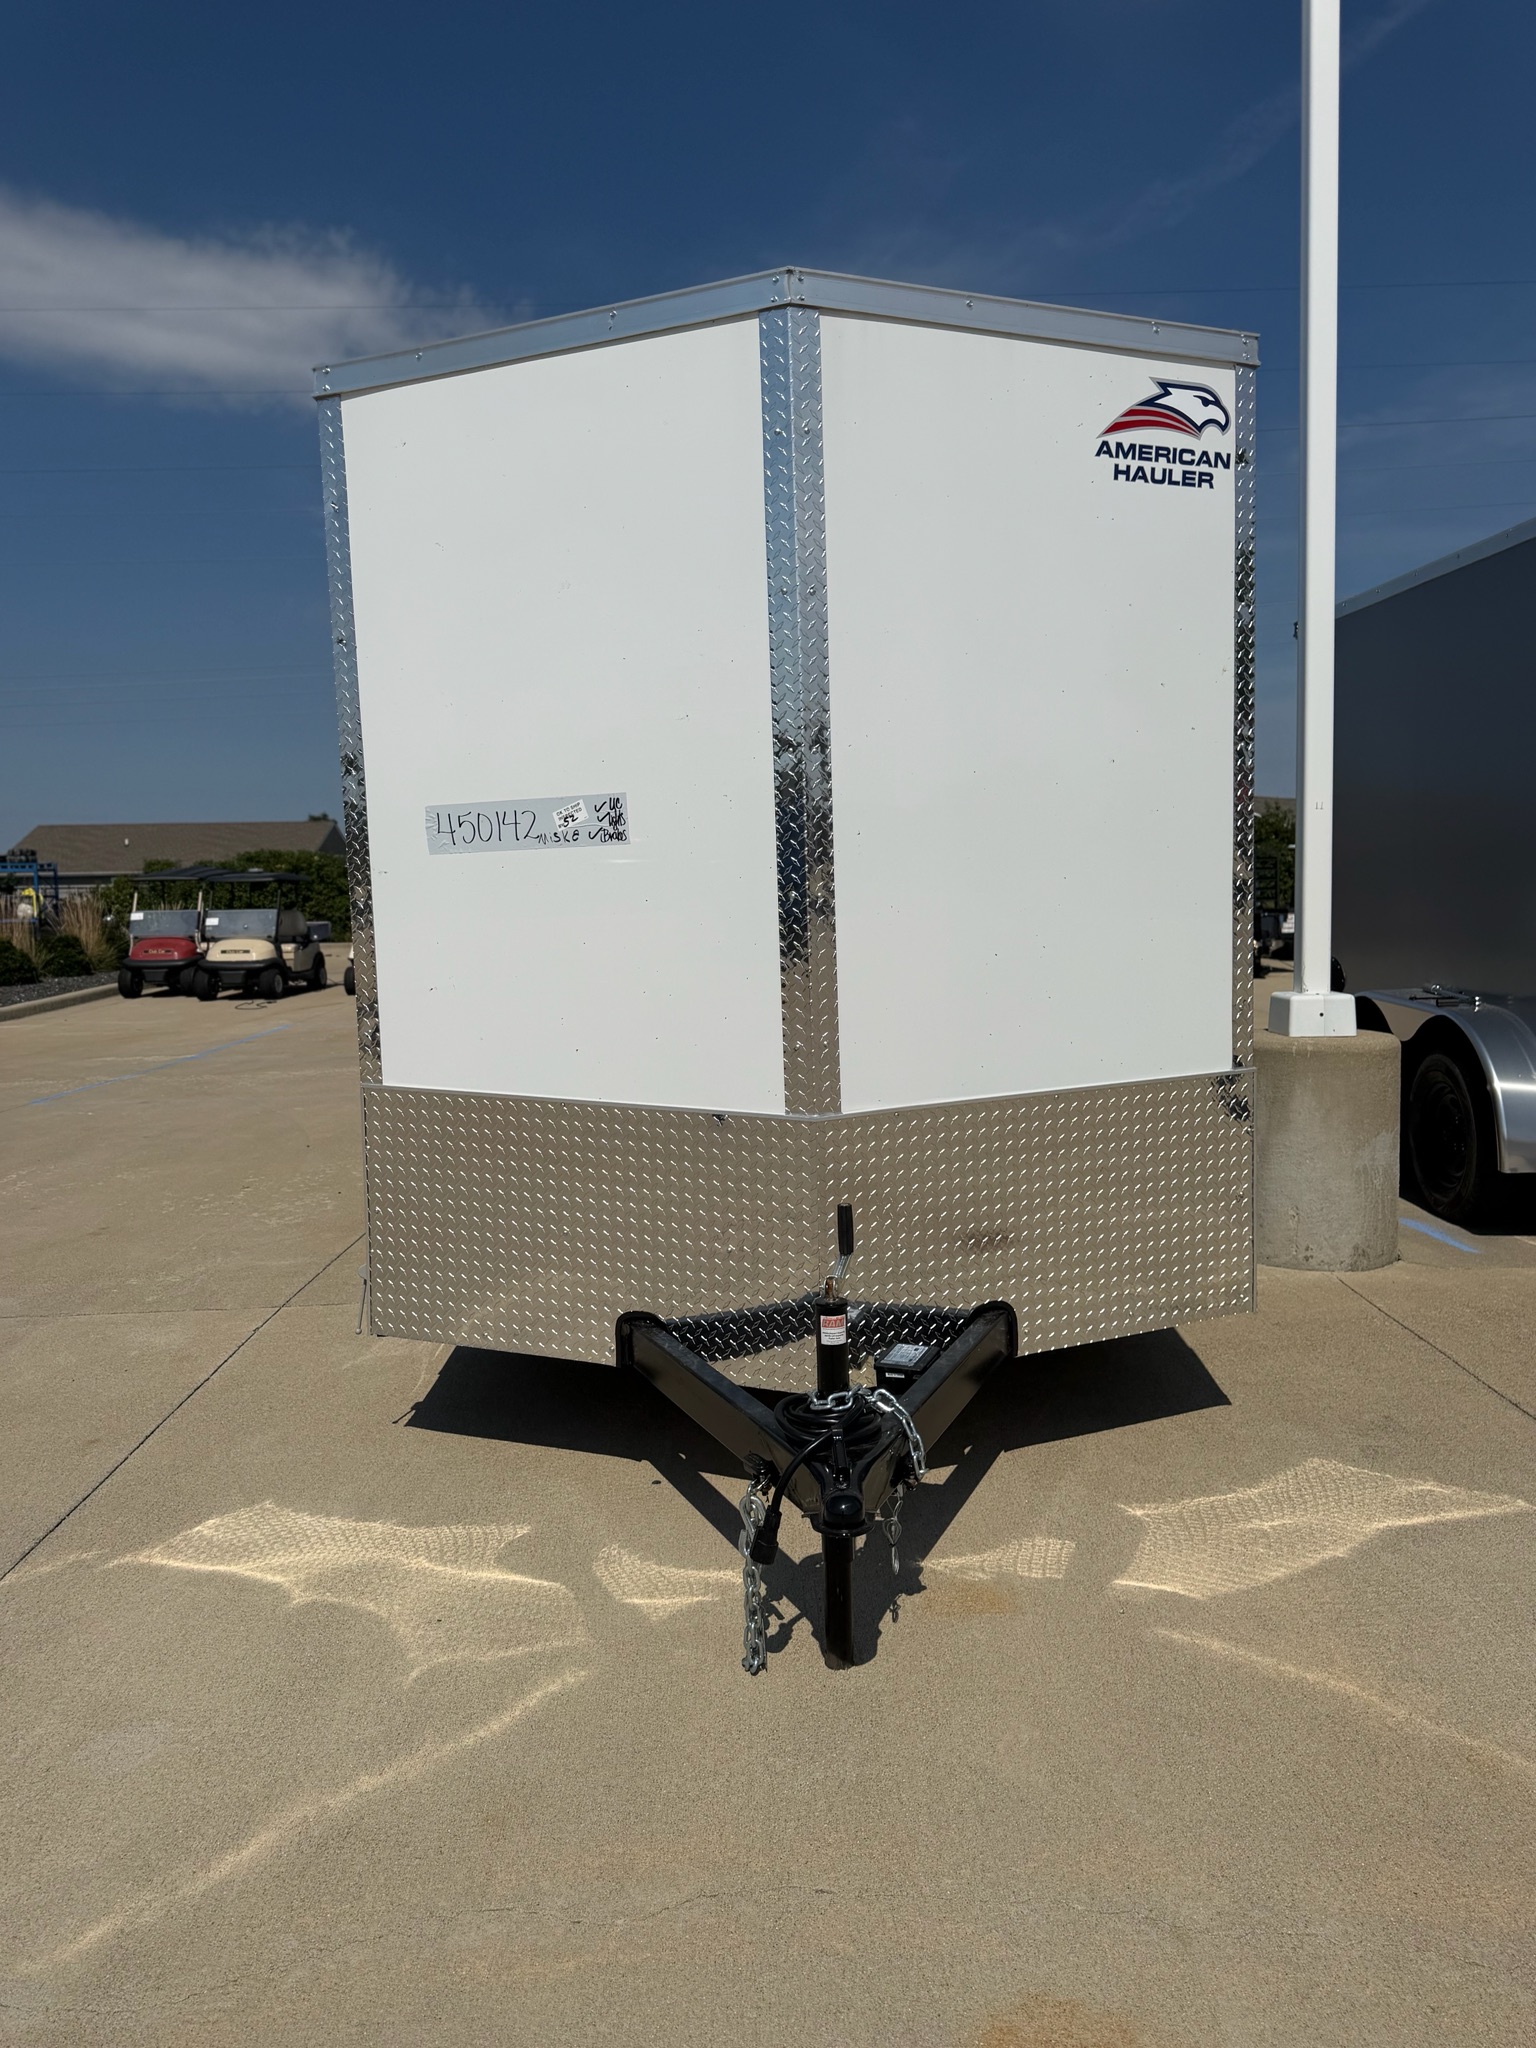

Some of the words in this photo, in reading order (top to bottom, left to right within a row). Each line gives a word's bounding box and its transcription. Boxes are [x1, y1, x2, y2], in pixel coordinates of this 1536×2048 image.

[1095, 440, 1231, 470] AMERICAN
[1113, 463, 1214, 489] HAULER
[437, 810, 540, 846] 450142
[822, 1318, 845, 1328] RAM
